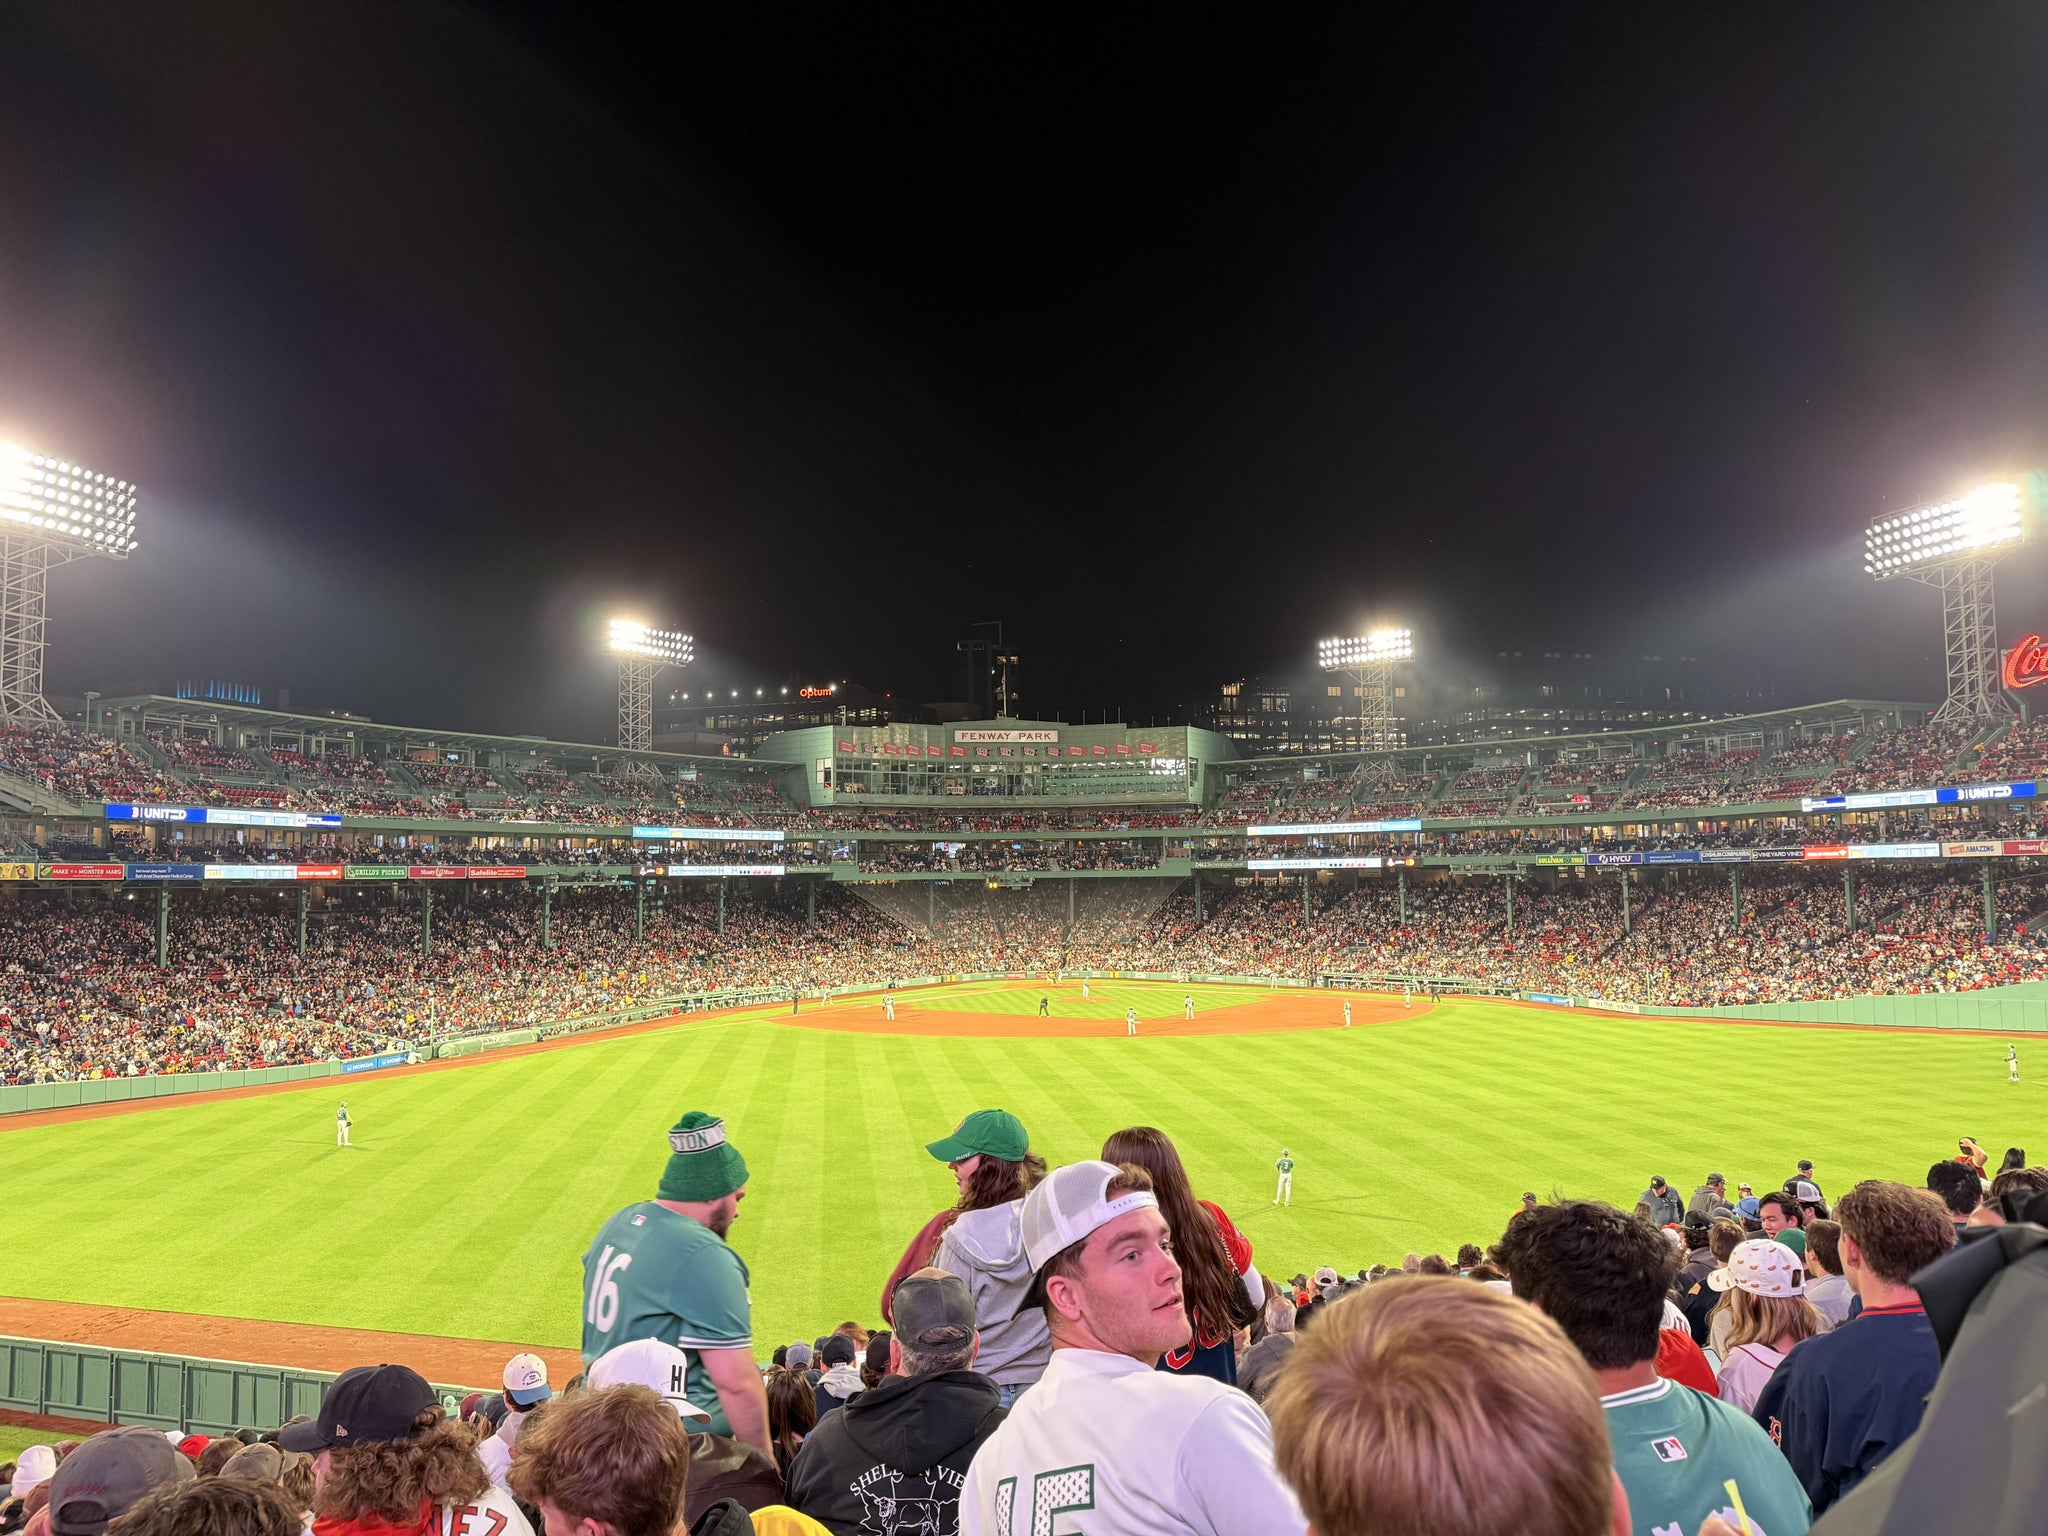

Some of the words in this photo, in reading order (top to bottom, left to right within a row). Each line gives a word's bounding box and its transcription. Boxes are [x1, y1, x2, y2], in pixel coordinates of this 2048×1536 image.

[800, 688, 832, 698] Optum
[1968, 786, 2012, 799] UNITED
[145, 807, 187, 820] UNITED
[353, 1062, 374, 1070] HONDA
[588, 1245, 632, 1333] 16
